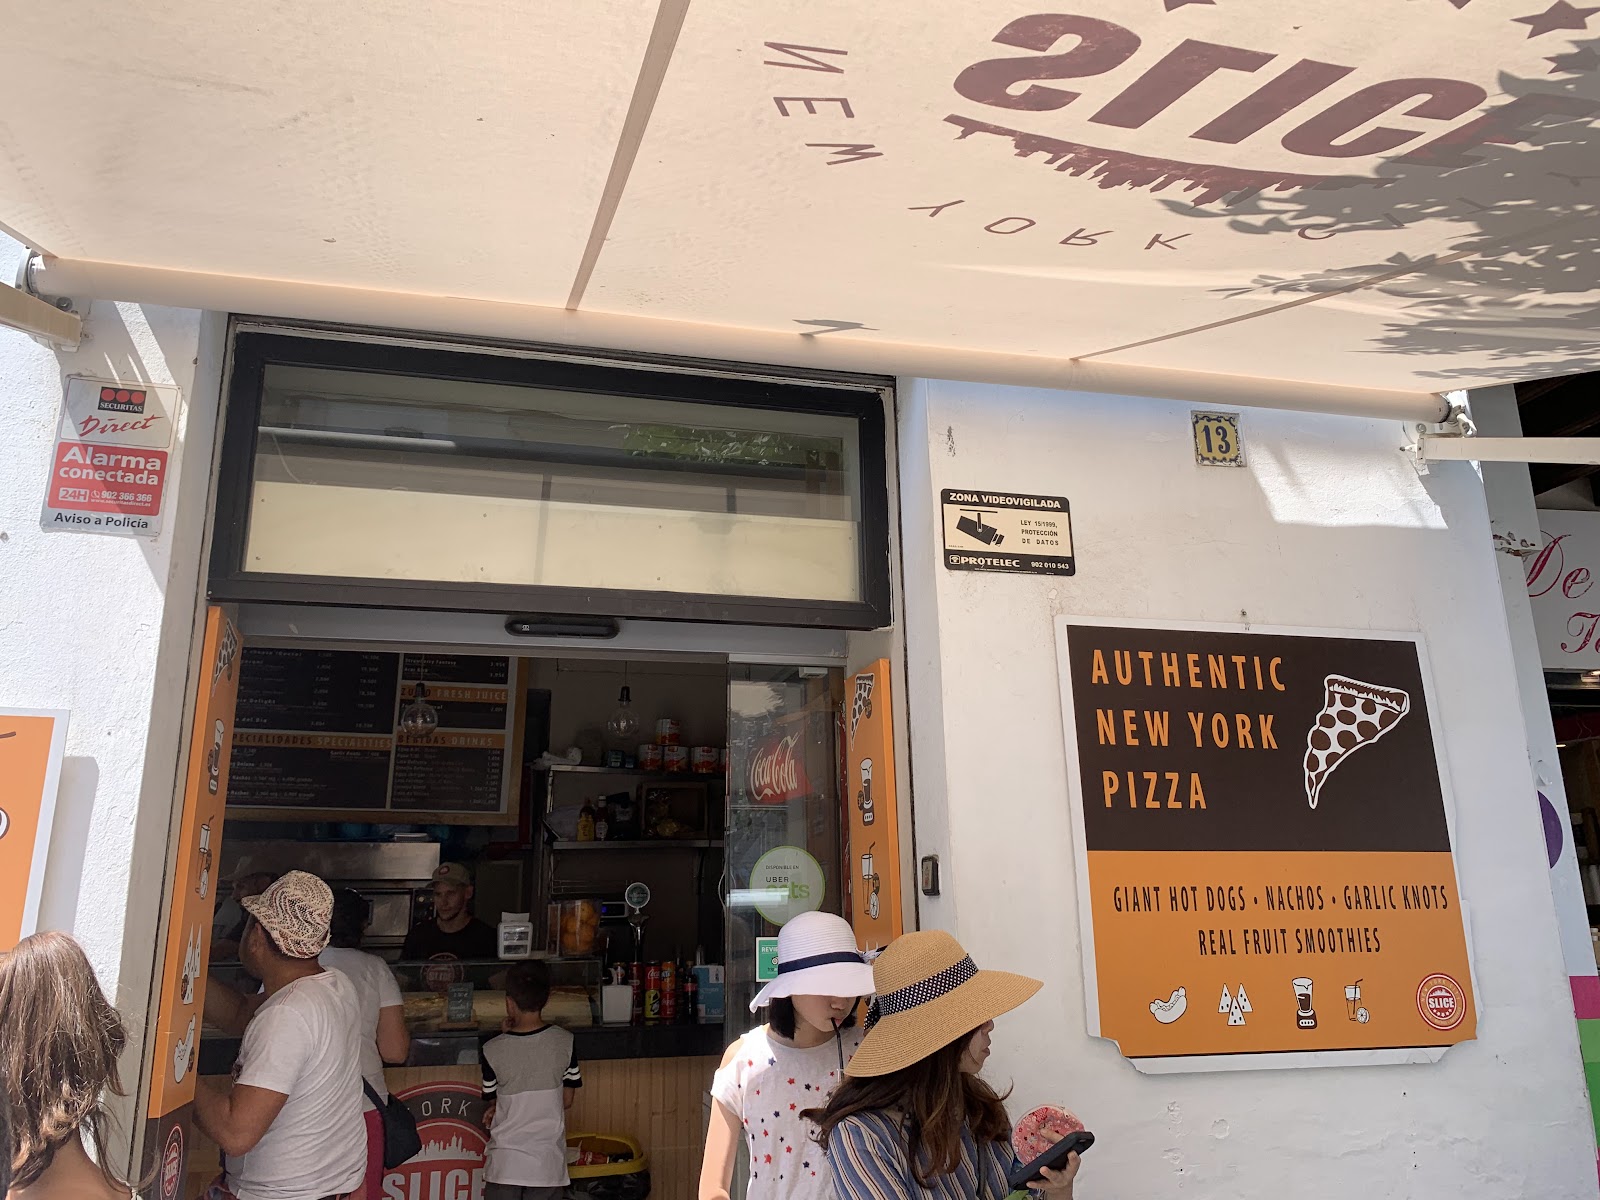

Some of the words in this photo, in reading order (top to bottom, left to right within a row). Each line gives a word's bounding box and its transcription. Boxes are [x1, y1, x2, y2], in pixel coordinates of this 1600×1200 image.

[100, 402, 143, 412] SECURITAS
[78, 414, 165, 438] Direct
[1201, 424, 1231, 454] 13
[62, 447, 161, 470] Alarma
[59, 467, 158, 485] conectada
[60, 489, 88, 501] 24H
[101, 490, 117, 500] 902
[949, 492, 980, 503] ZONA
[981, 494, 1061, 509] VIDEOVIGILADA
[54, 512, 92, 526] Aviso
[94, 517, 102, 526] a
[105, 516, 149, 529] Policía
[1036, 538, 1059, 546] DATOS
[961, 556, 1020, 568] PROTELEC
[1521, 529, 1595, 599] De
[1555, 611, 1600, 654] T
[1092, 649, 1286, 691] AUTHENTIC
[400, 687, 431, 698] ZUO
[437, 688, 472, 699] FRESH
[476, 690, 506, 701] JUICE
[1097, 708, 1169, 747] NEW
[1188, 711, 1278, 750] YORK
[233, 733, 312, 745] PECIALIDADES
[317, 736, 392, 749] SPECIALITIES
[451, 736, 493, 747] DRINKS
[1103, 771, 1207, 810] PIZZA
[1113, 886, 1161, 912] GIANT
[1169, 886, 1198, 912] HOT
[1207, 886, 1246, 912] DOGS
[1266, 885, 1324, 911] NACHOS
[1343, 885, 1398, 911] GARLIC
[1403, 885, 1449, 910] KNOTS
[1198, 929, 1235, 956] REAL
[1244, 928, 1288, 955] FRUIT
[1295, 927, 1382, 954] SMOOTHIES
[1428, 997, 1455, 1009] SLICE
[407, 1097, 472, 1117] ORK
